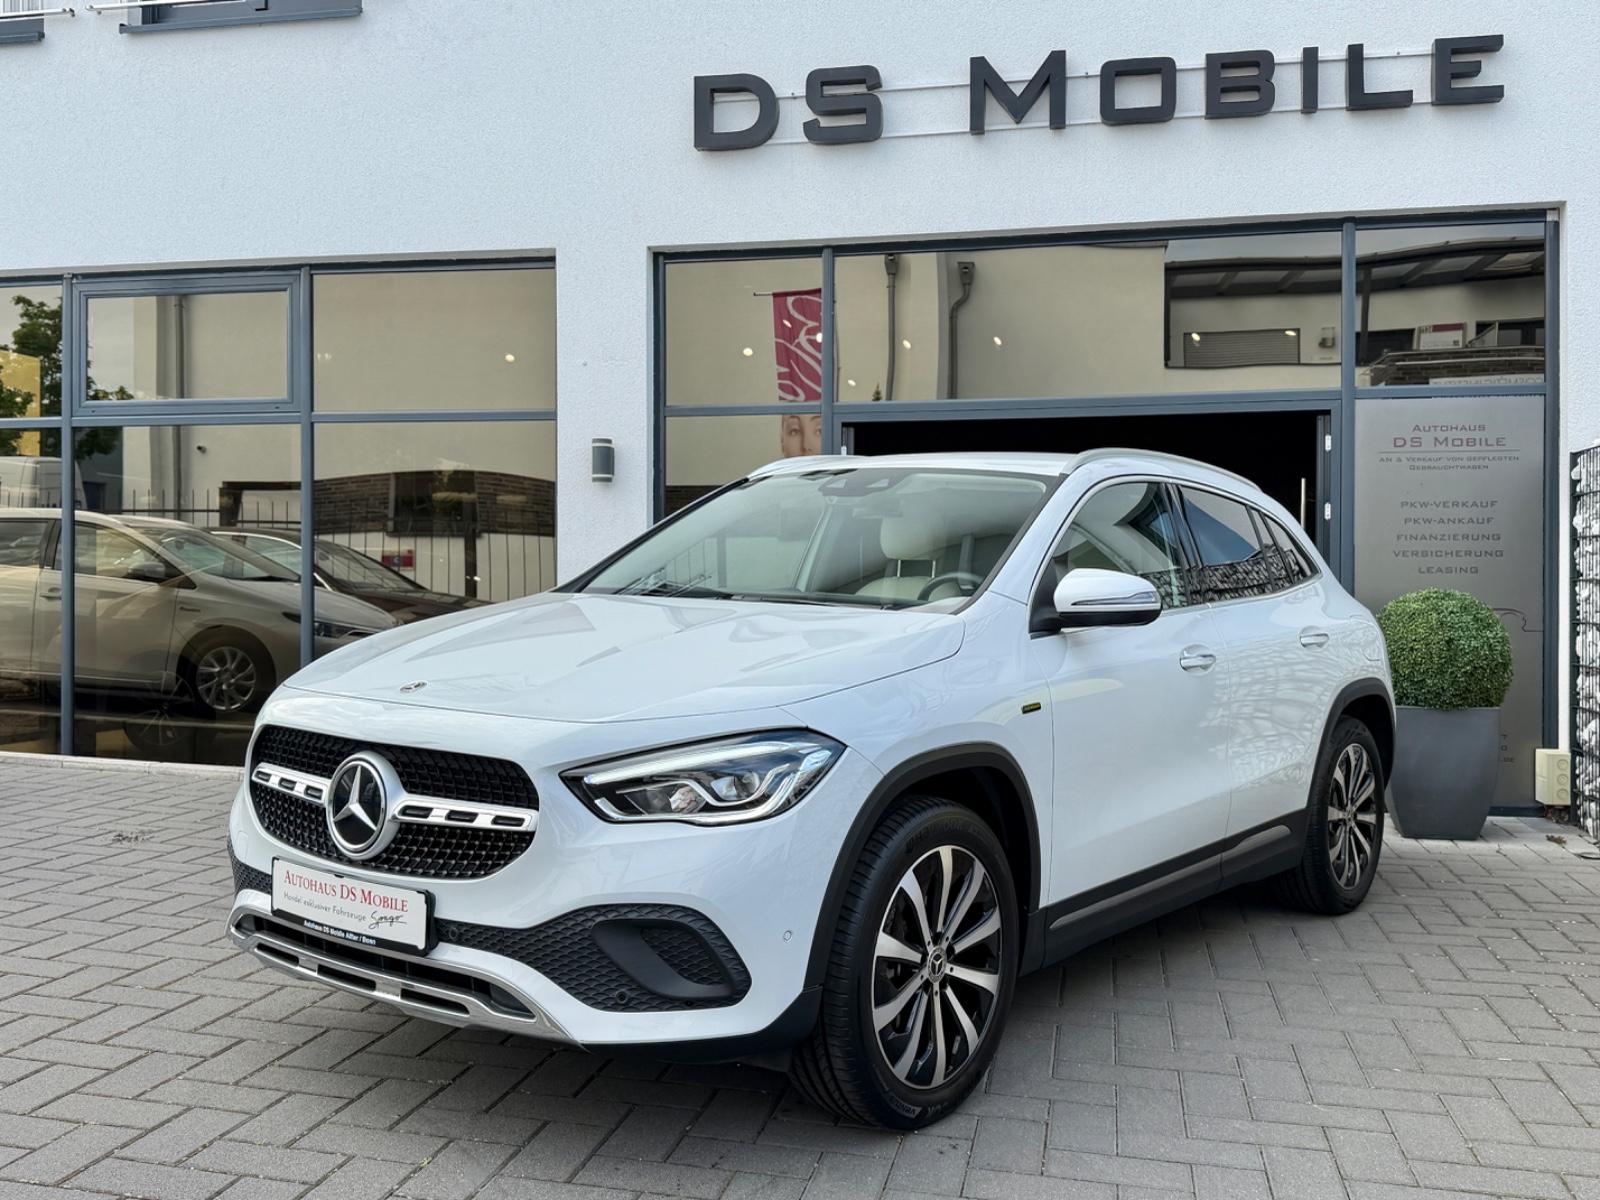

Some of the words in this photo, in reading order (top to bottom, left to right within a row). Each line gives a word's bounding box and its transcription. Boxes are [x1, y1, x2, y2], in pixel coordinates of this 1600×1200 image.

[693, 64, 885, 152] DS
[969, 34, 1505, 136] MOBILE
[1412, 424, 1486, 433] AUTOHAUS
[1393, 437, 1423, 448] DS
[1433, 436, 1507, 448] MOBILE
[1400, 500, 1499, 509] PKW-VERKAUF
[1404, 517, 1495, 525] PKW-ANKAUF
[1396, 533, 1502, 542] FINANZIERUNG
[1393, 549, 1505, 558] VERSICHERUNG
[1418, 566, 1480, 574] LEASING
[284, 870, 337, 897] AUTOHAUS
[340, 884, 358, 902] DS
[360, 888, 409, 912] MOBILE
[332, 905, 367, 921] Fahrzeuge
[330, 927, 345, 938] Mobile
